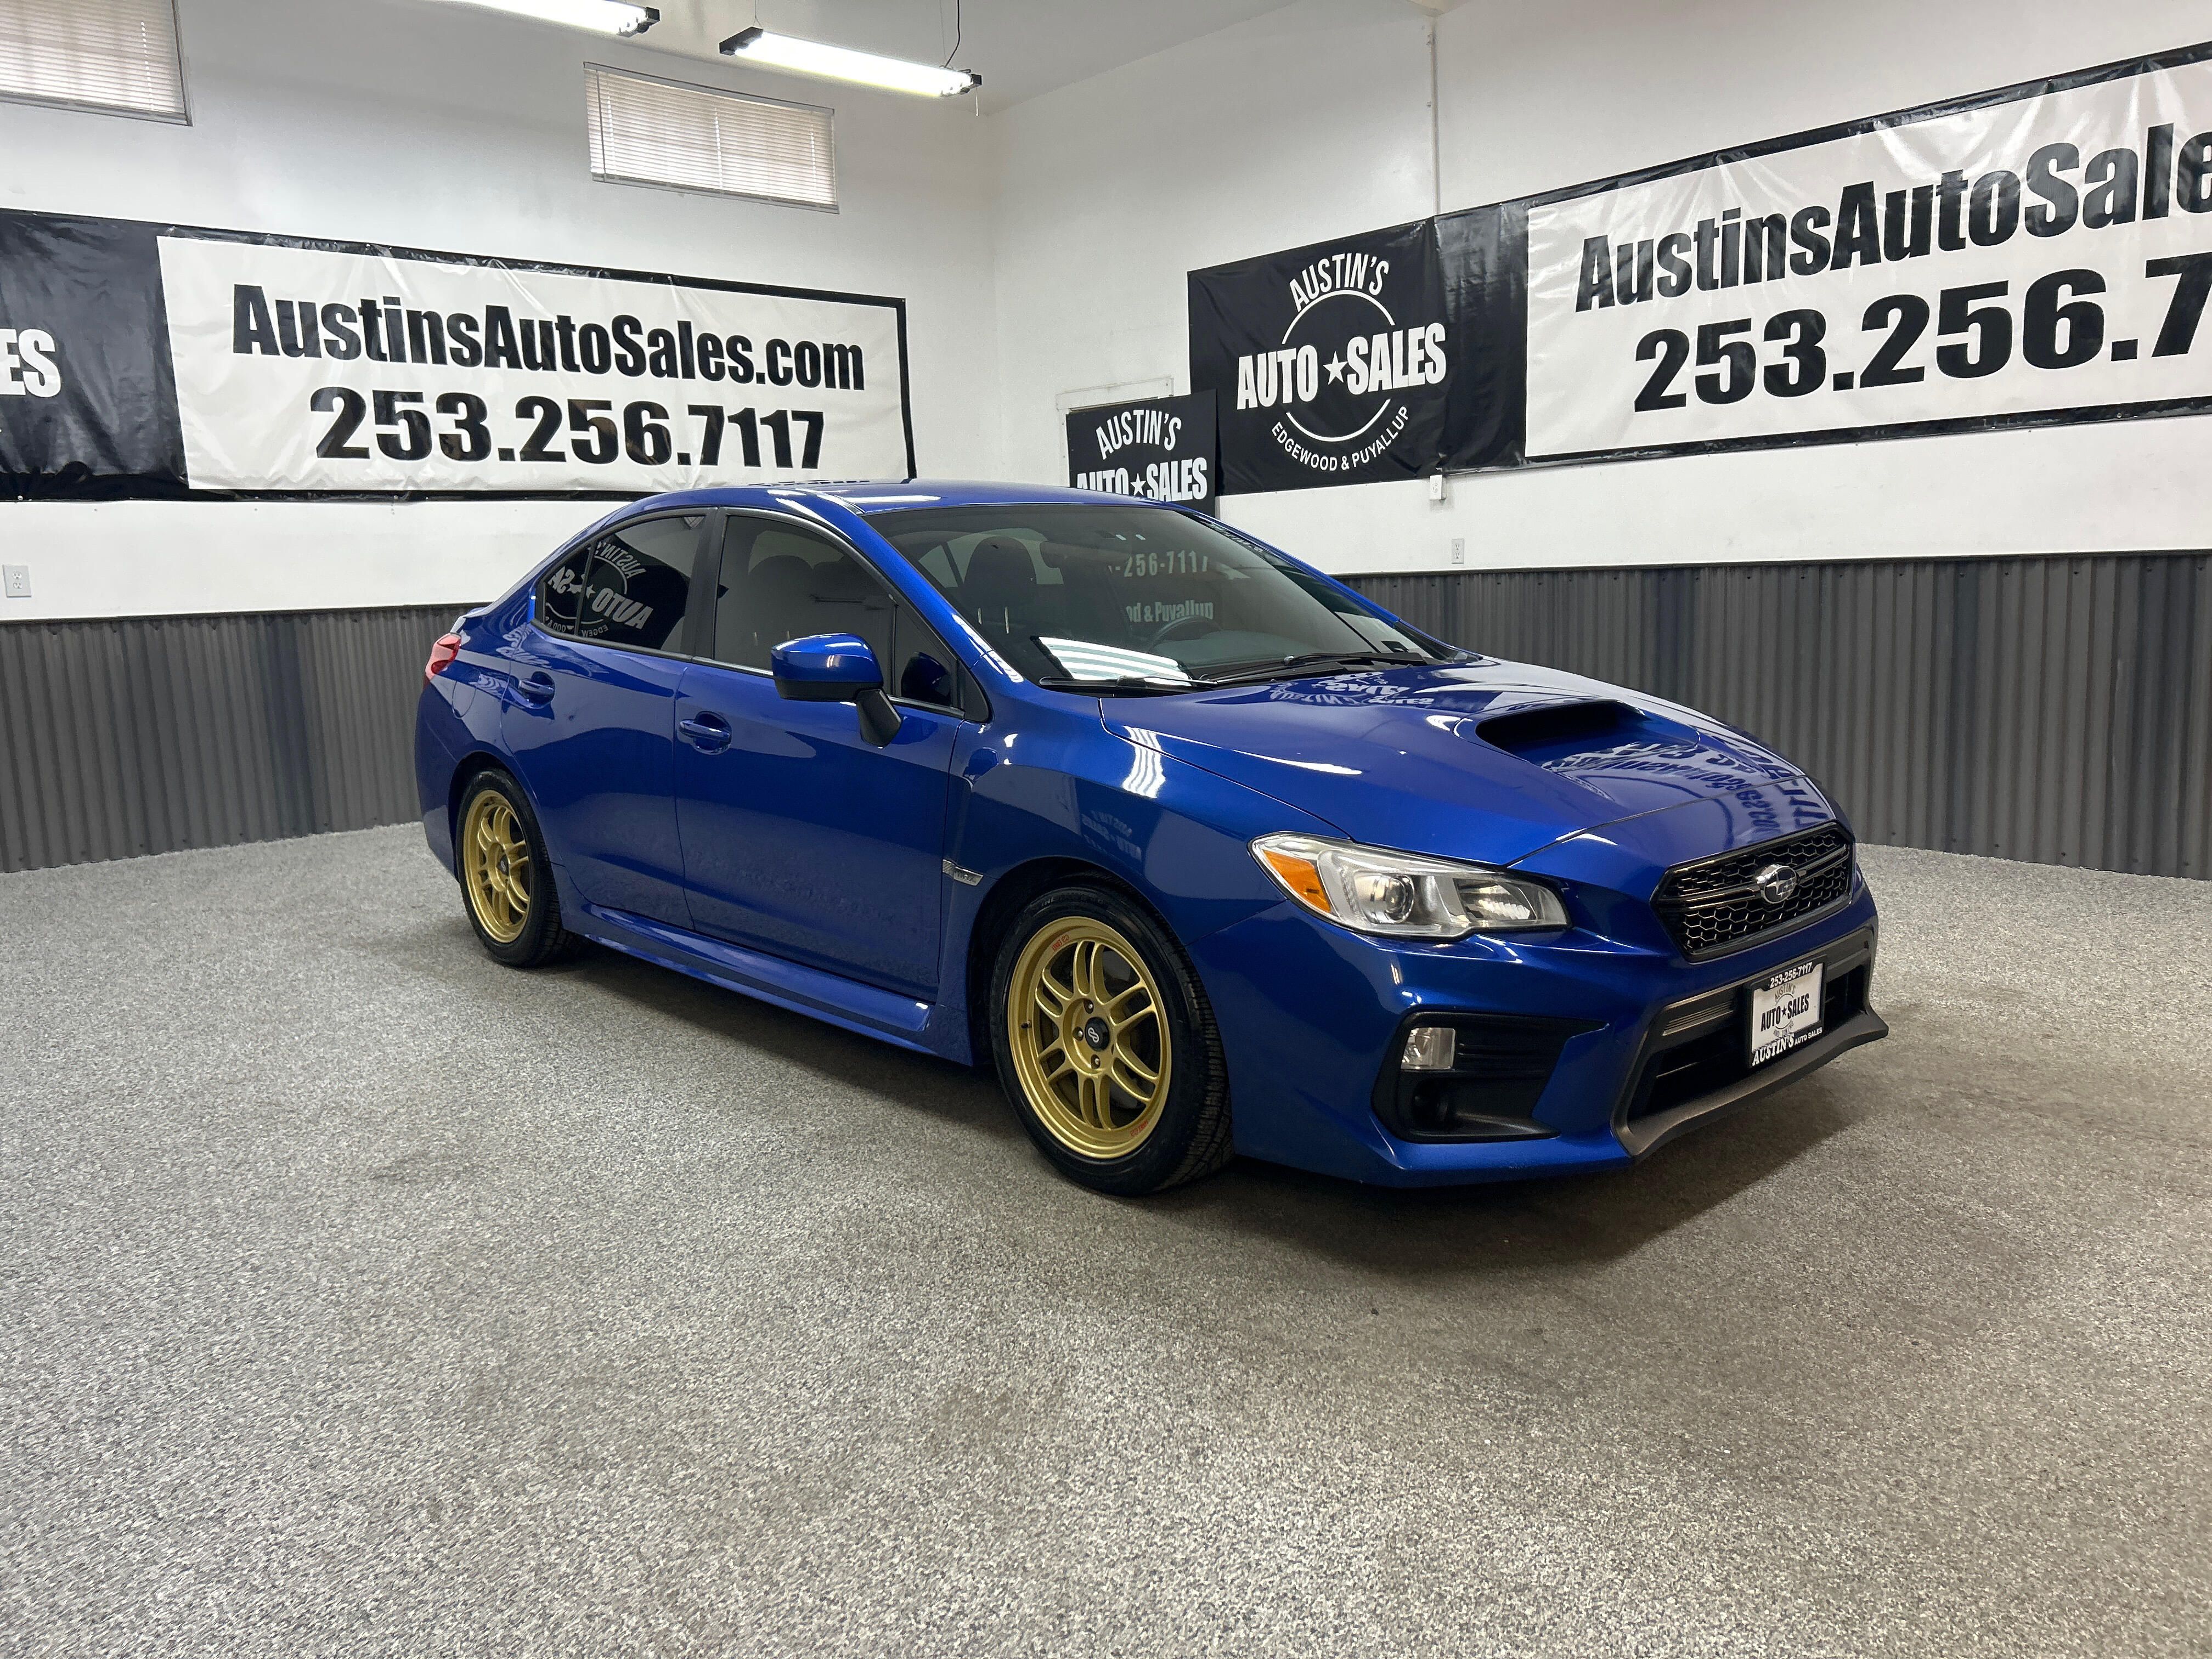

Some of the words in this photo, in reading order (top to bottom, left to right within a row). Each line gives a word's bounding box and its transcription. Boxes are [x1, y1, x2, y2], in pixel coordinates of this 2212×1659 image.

[1289, 252, 1389, 312] AUSTIN'S
[233, 284, 865, 390] AustinsAutoSales.com
[1634, 252, 2212, 413] 253.256.7
[1237, 344, 1318, 410] AUTO
[1347, 322, 1446, 394] SALES
[310, 386, 824, 469] 253.256.7117
[1096, 409, 1182, 460] AUSTIN'S
[1271, 421, 1338, 471] EDGEWOOD
[1341, 455, 1350, 470] &
[1351, 406, 1409, 467] PUYALLUP
[1146, 457, 1207, 503] SALES
[1770, 962, 1812, 988] 253-256-7117
[1760, 1006, 1781, 1032] AUTO
[1787, 993, 1809, 1019] SALES
[1752, 1034, 1794, 1066] AUSTIN'S
[1794, 1034, 1807, 1046] AUTO
[1808, 1027, 1822, 1040] SALES
